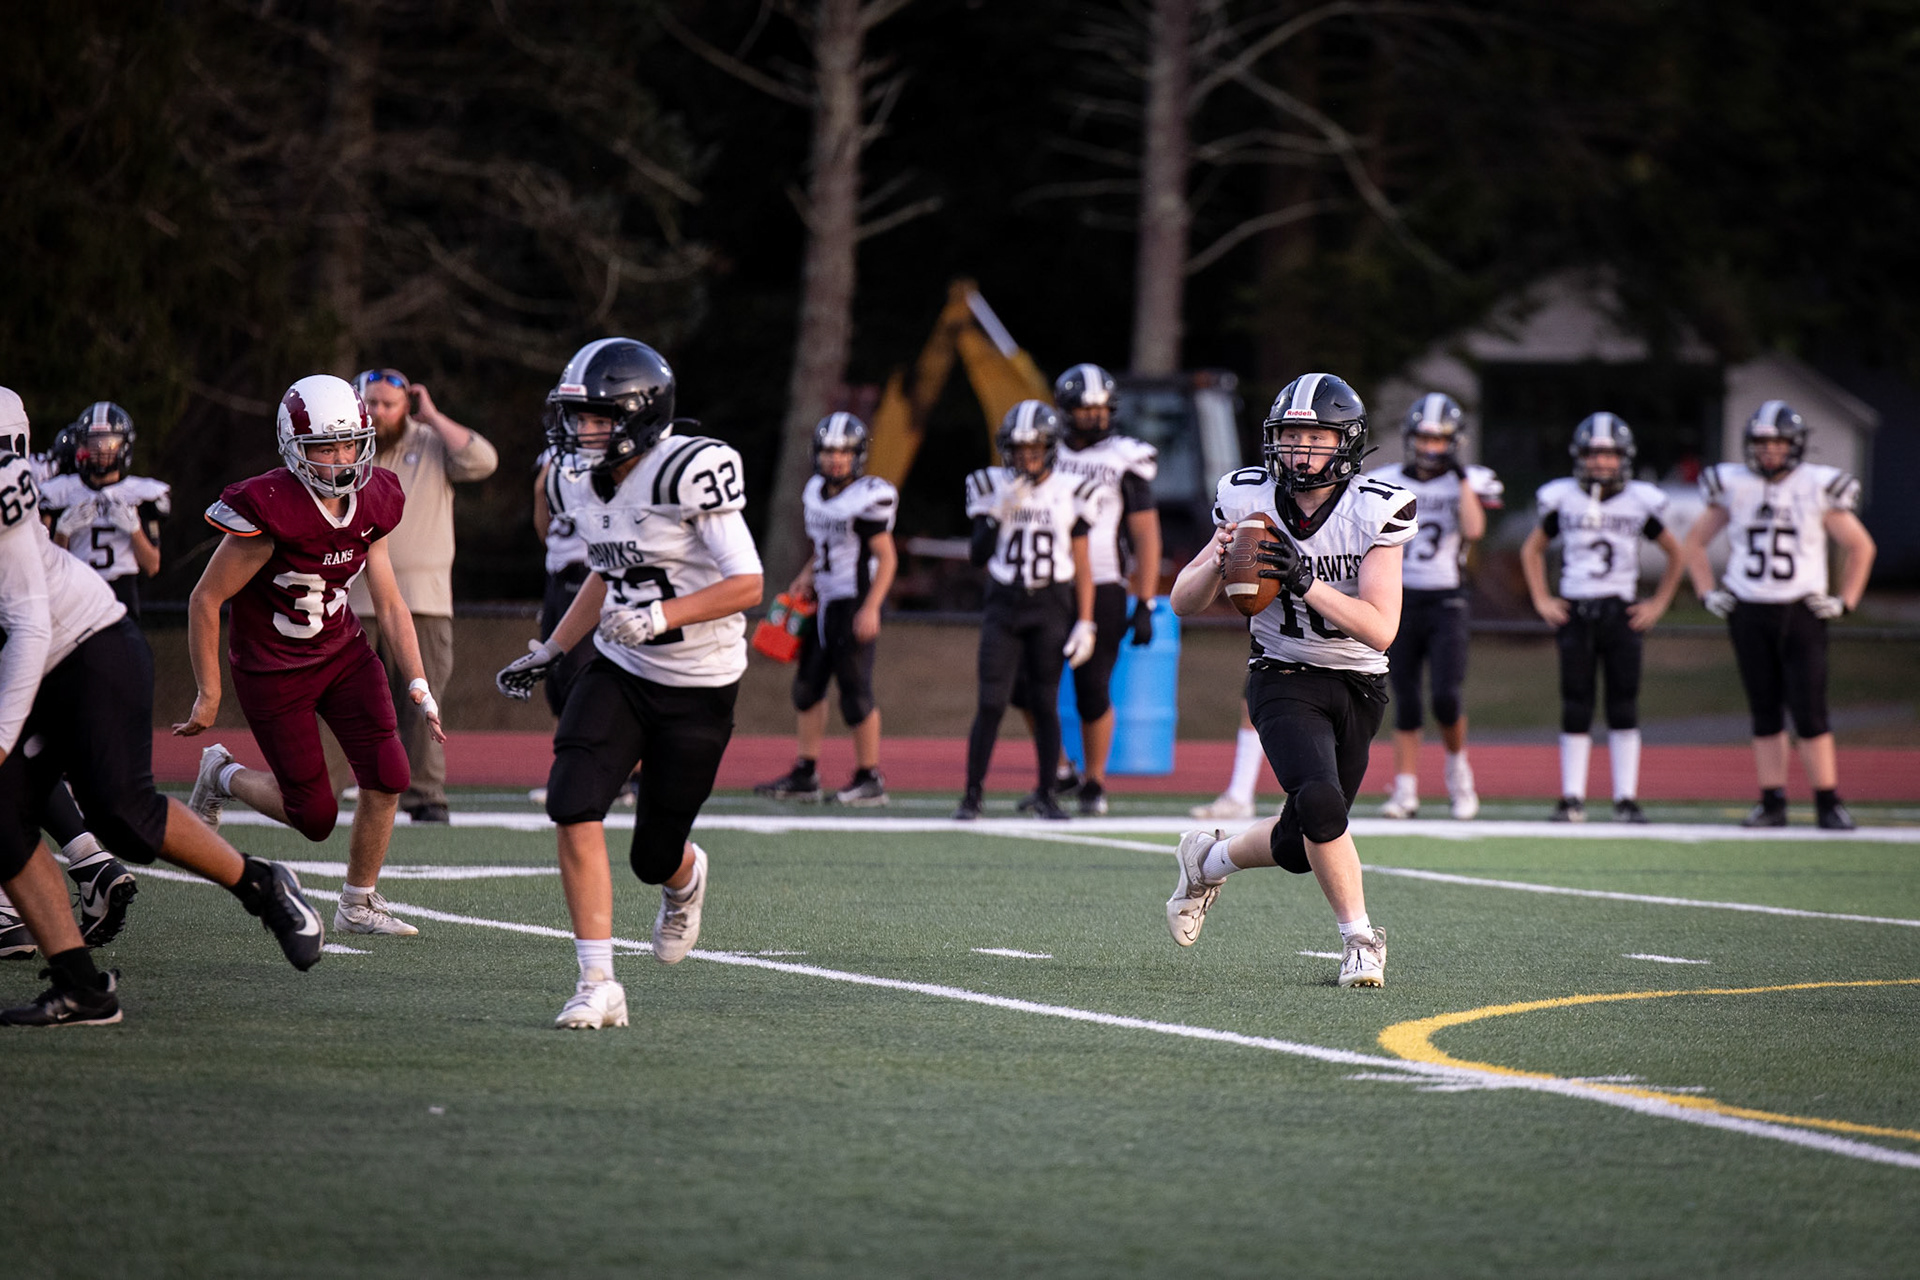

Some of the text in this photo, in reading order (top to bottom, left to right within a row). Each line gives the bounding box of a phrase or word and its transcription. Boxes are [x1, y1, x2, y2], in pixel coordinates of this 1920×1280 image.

[0, 469, 37, 526] 69
[692, 461, 741, 510] 32
[89, 526, 115, 569] 5
[322, 549, 355, 566] RAMS
[1006, 529, 1055, 582] 48
[1587, 539, 1614, 578] 3
[1745, 527, 1797, 581] 55
